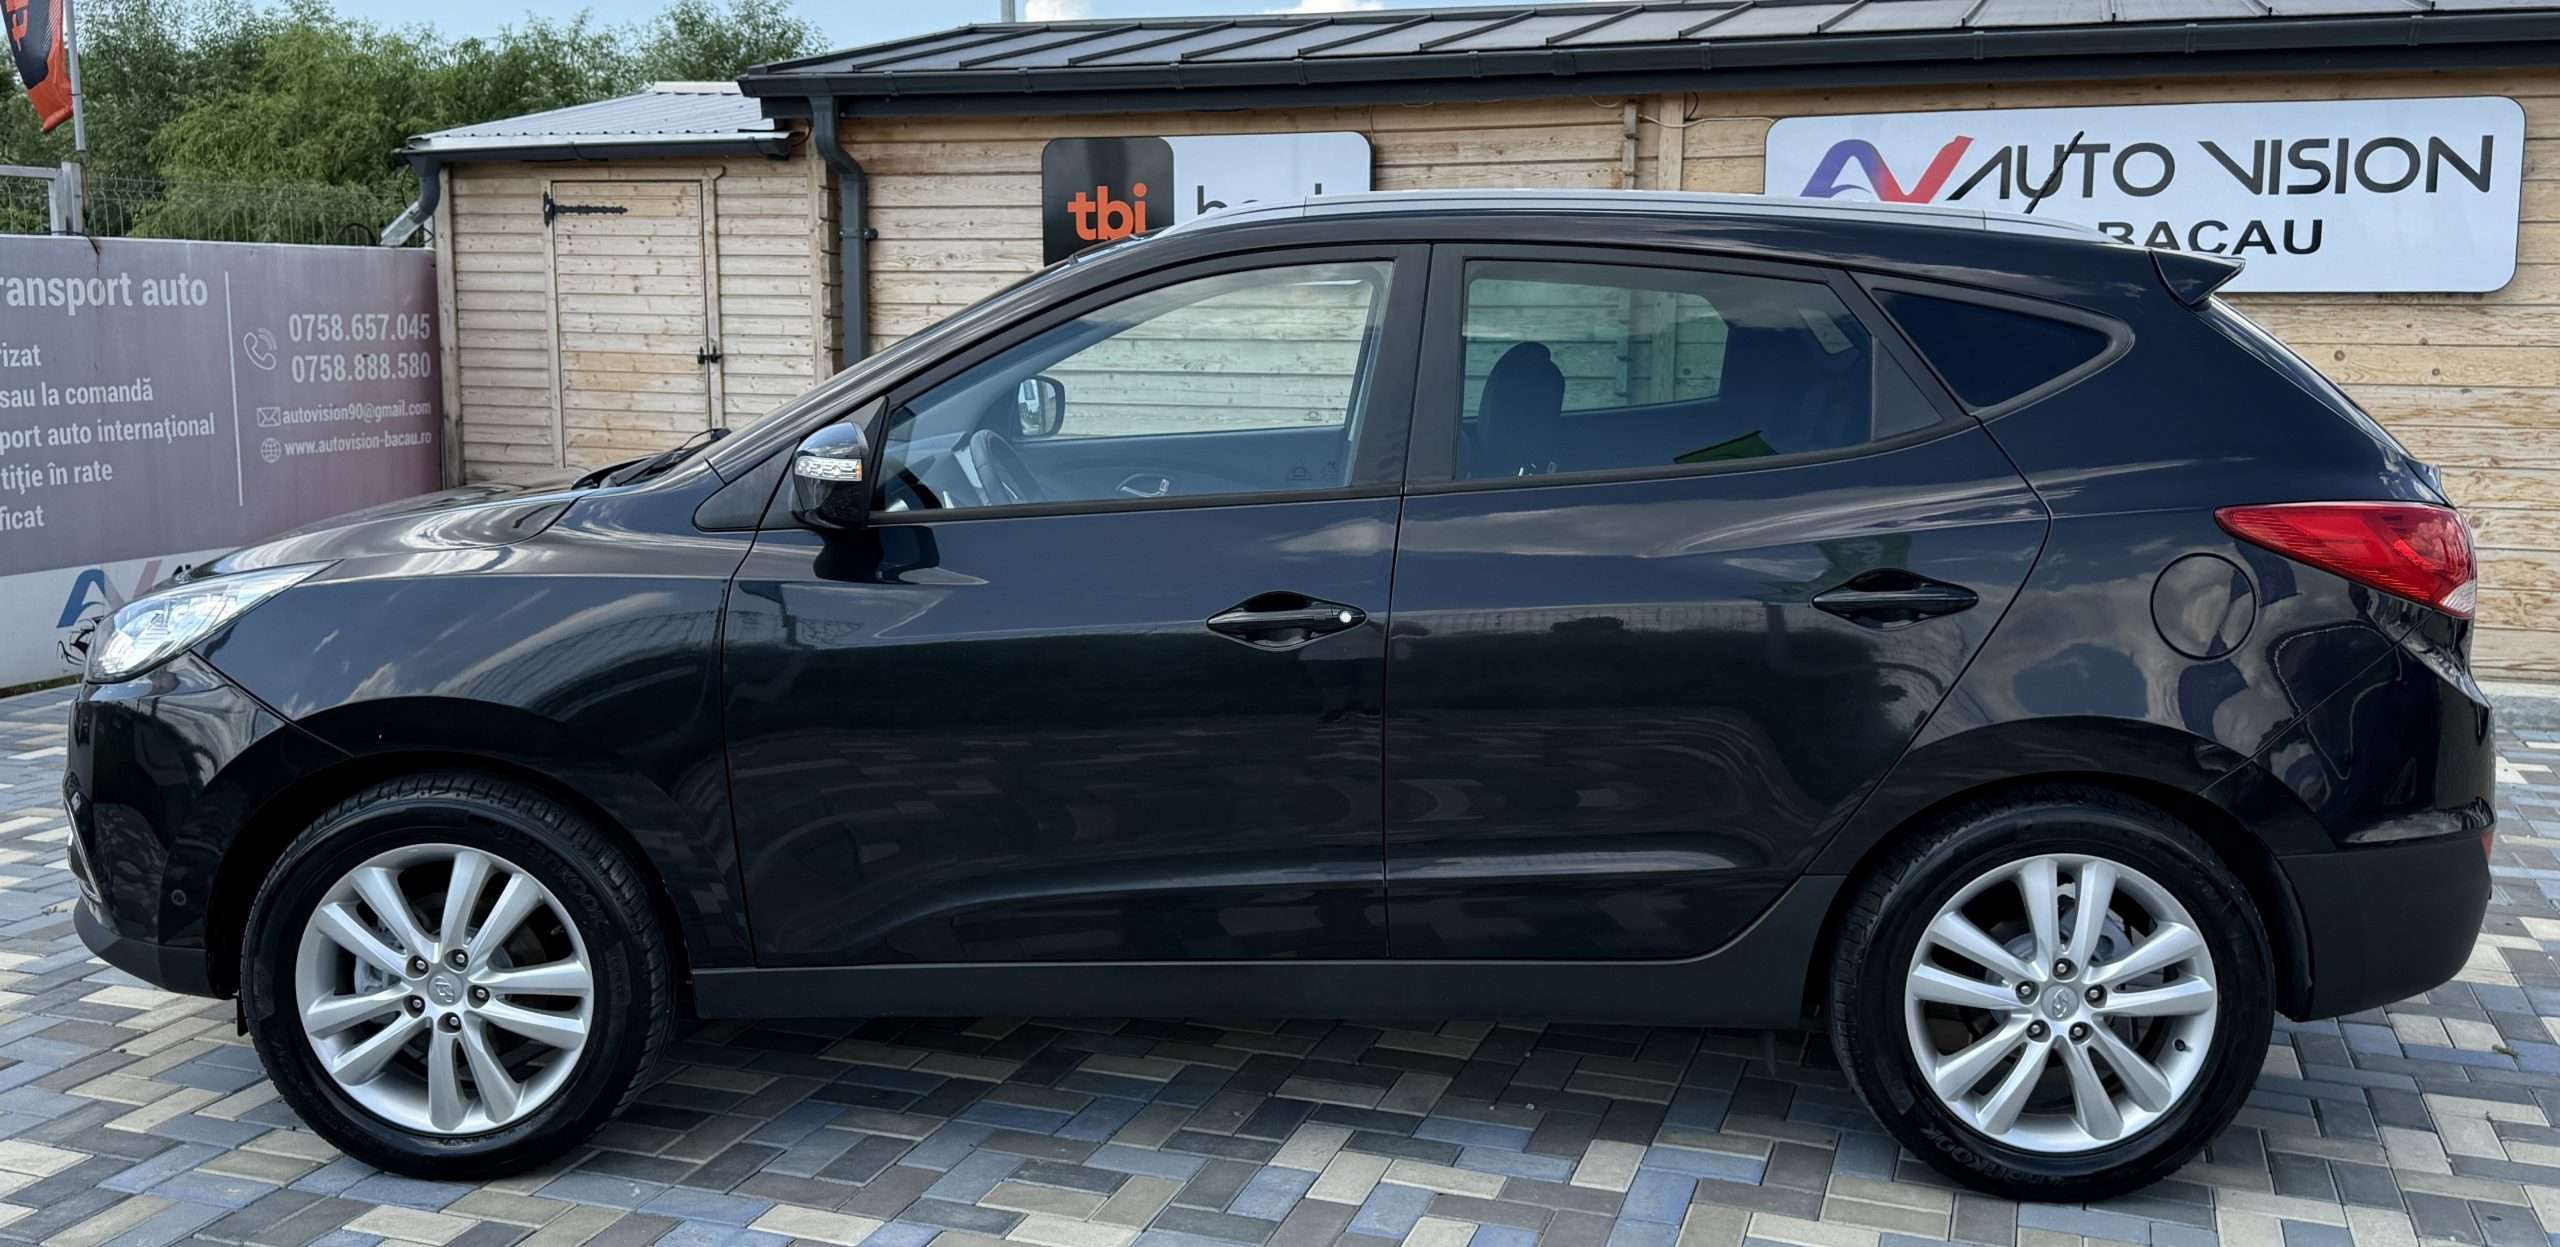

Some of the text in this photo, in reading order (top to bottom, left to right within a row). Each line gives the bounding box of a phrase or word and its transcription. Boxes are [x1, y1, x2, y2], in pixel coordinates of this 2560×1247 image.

[1946, 143, 2176, 201] AUTO
[2197, 135, 2494, 196] VISION
[1067, 182, 1148, 241] tbi
[2098, 219, 2323, 256] BACAU
[142, 273, 208, 306] auto
[289, 313, 430, 342] 0758.657.045
[0, 342, 42, 367] izat
[291, 352, 431, 383] 0758.888.580
[41, 382, 60, 406] la
[65, 378, 153, 405] comandă
[282, 400, 431, 424] autovision90@gmail.com
[48, 423, 92, 446] auto
[284, 430, 432, 457] www.autovision-bacau.ro
[48, 462, 68, 486] în
[74, 460, 113, 483] rate
